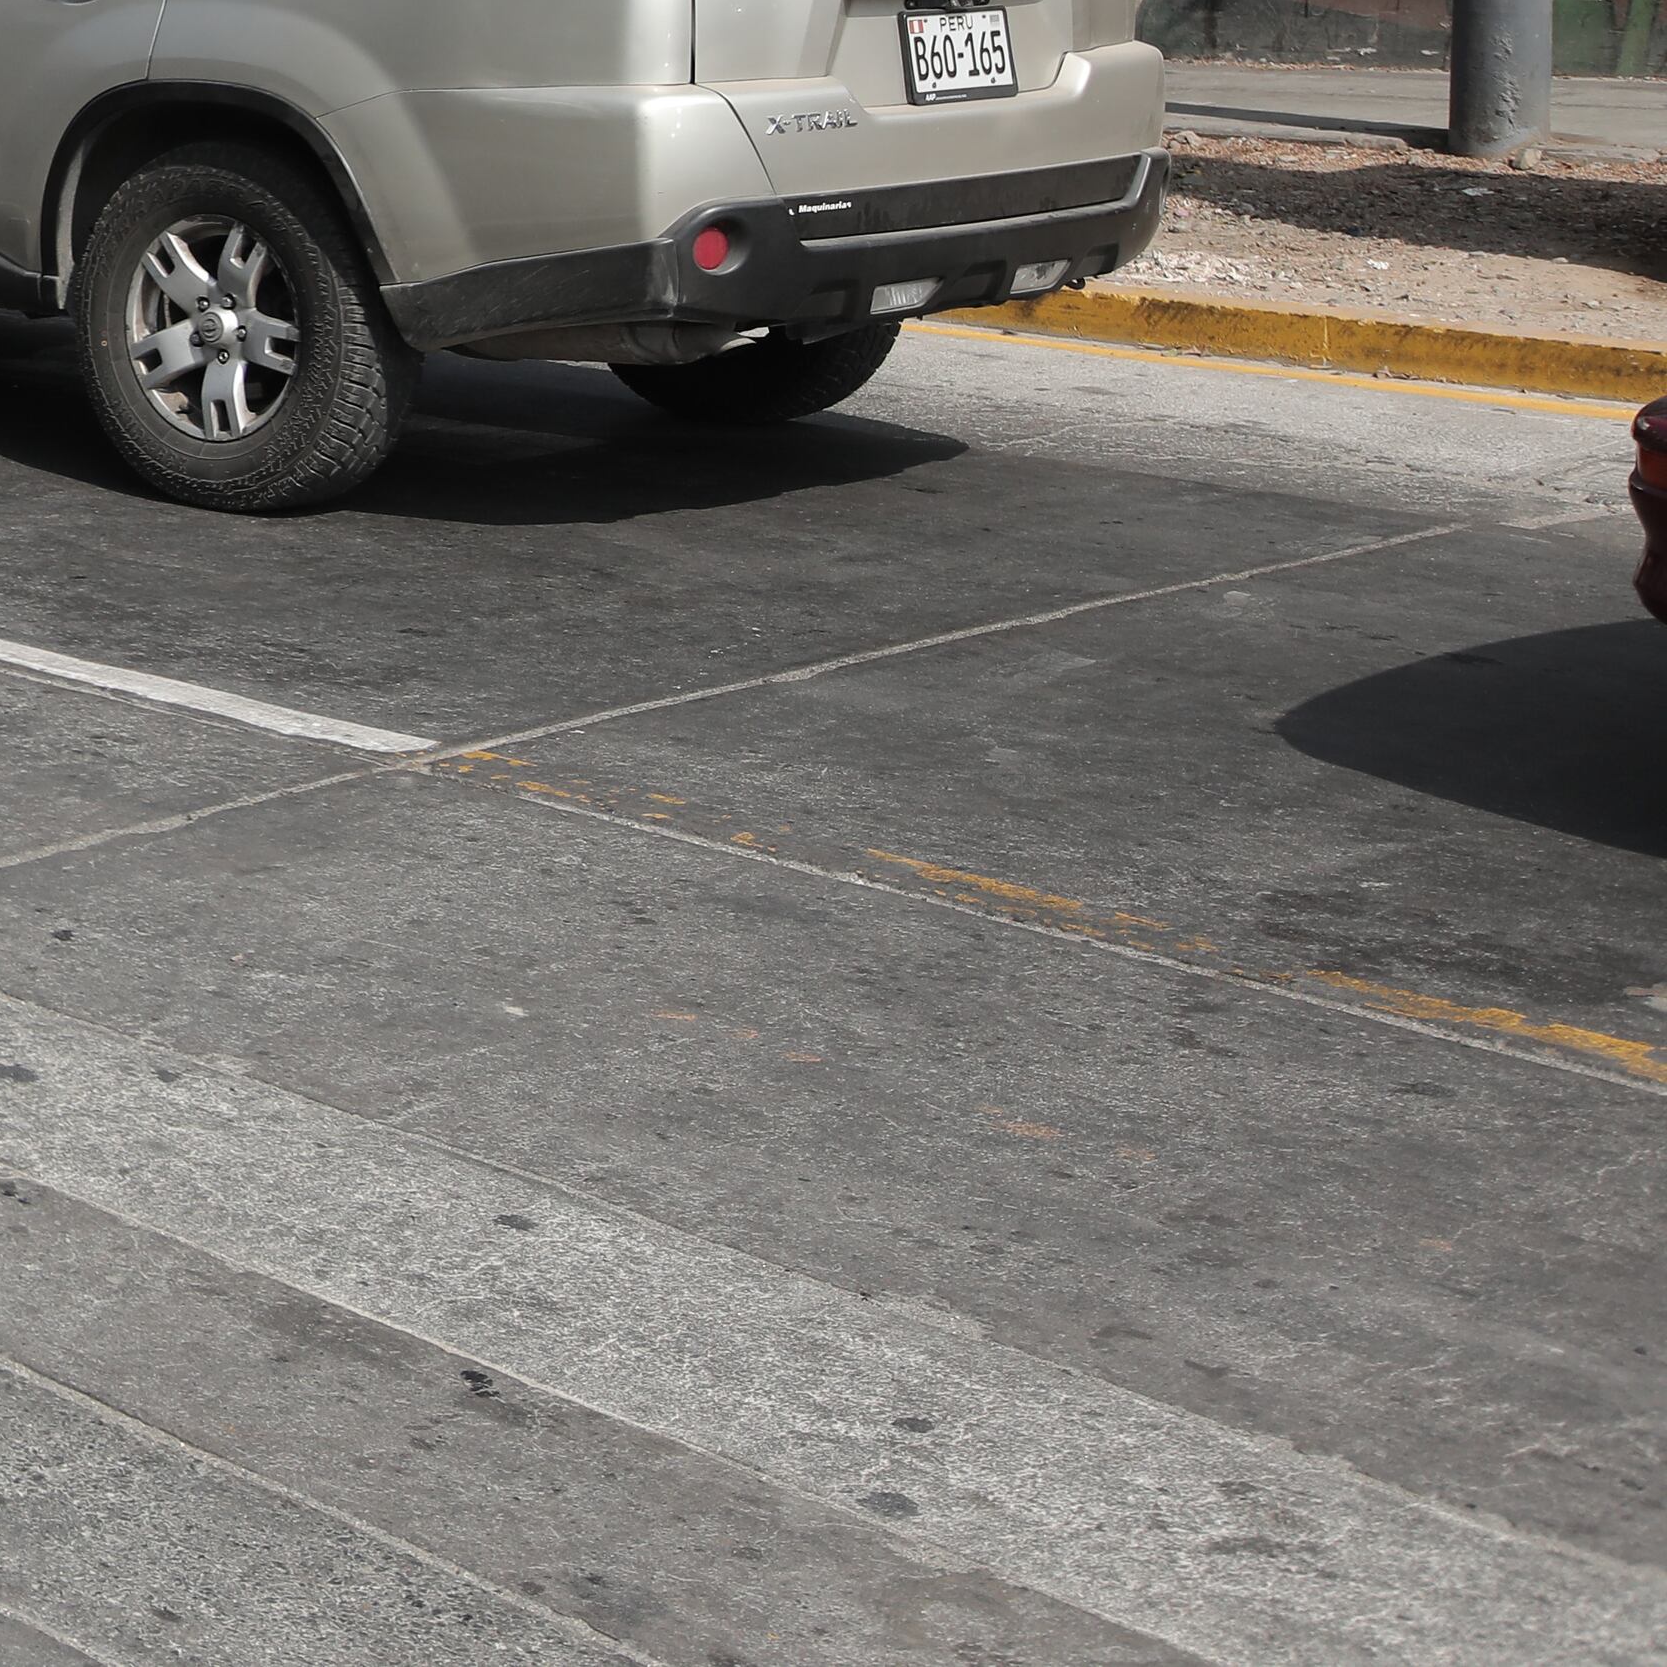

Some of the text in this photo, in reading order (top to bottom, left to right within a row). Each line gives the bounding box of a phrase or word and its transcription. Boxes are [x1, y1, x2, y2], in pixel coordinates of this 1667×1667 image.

[939, 15, 974, 32] PERU
[914, 30, 1006, 81] B60-165
[766, 109, 858, 135] X-TRAIL
